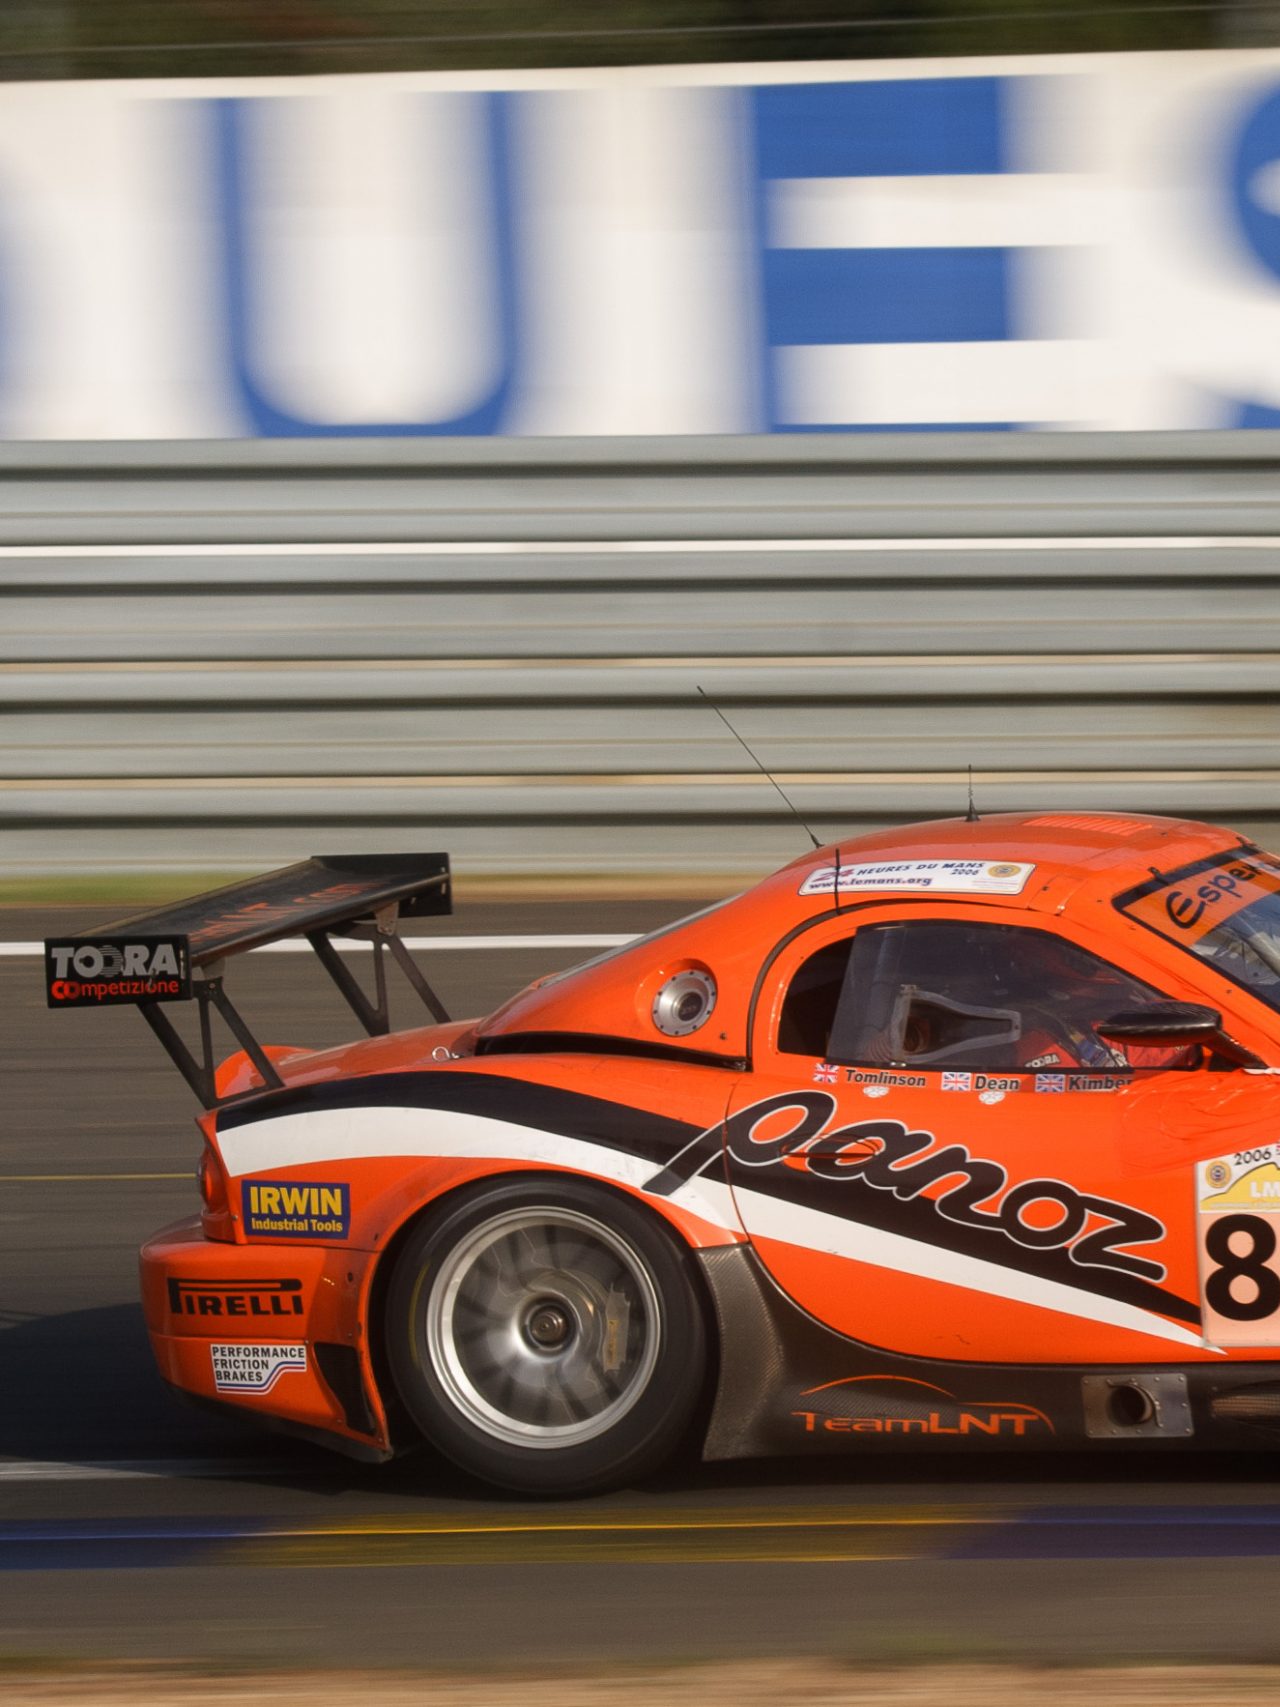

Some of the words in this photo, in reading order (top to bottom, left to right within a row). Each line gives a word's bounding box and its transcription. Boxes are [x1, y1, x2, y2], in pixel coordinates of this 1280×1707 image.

[857, 865, 909, 876] HEURES
[942, 862, 985, 870] MANS
[951, 868, 979, 876] 2006
[51, 943, 179, 979] TOORA
[845, 1069, 926, 1087] Tomlinson
[974, 1075, 1020, 1091] Dean
[1233, 1148, 1272, 1166] 2006
[249, 1186, 343, 1216] IRWIN
[251, 1218, 309, 1232] Industrial
[311, 1219, 343, 1232] Tools
[168, 1278, 304, 1316] PIRELLI
[212, 1346, 305, 1359] PERFORMANCE
[213, 1359, 269, 1370] FRICTION
[215, 1371, 263, 1382] BRAKES
[790, 1411, 1040, 1437] TeamLNT
